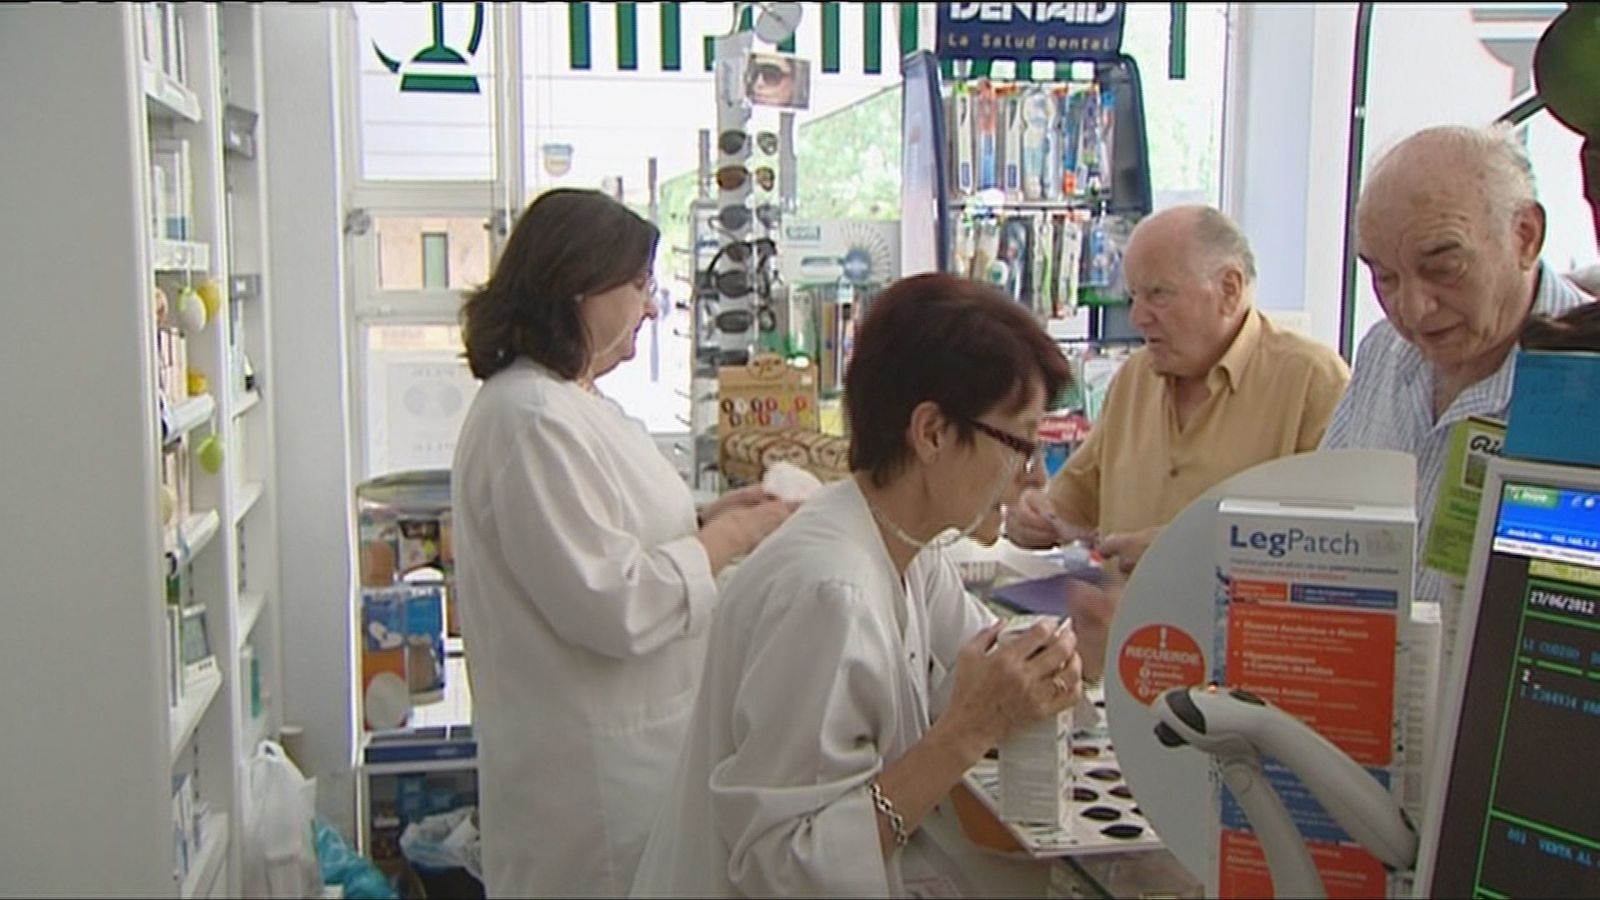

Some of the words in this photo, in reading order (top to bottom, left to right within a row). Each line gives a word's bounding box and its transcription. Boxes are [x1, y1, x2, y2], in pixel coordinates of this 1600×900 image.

[948, 33, 969, 47] La
[982, 34, 1037, 48] Salud
[1047, 37, 1110, 50] Dental
[1230, 525, 1360, 557] LegPatch
[1125, 645, 1200, 667] RECUERDE
